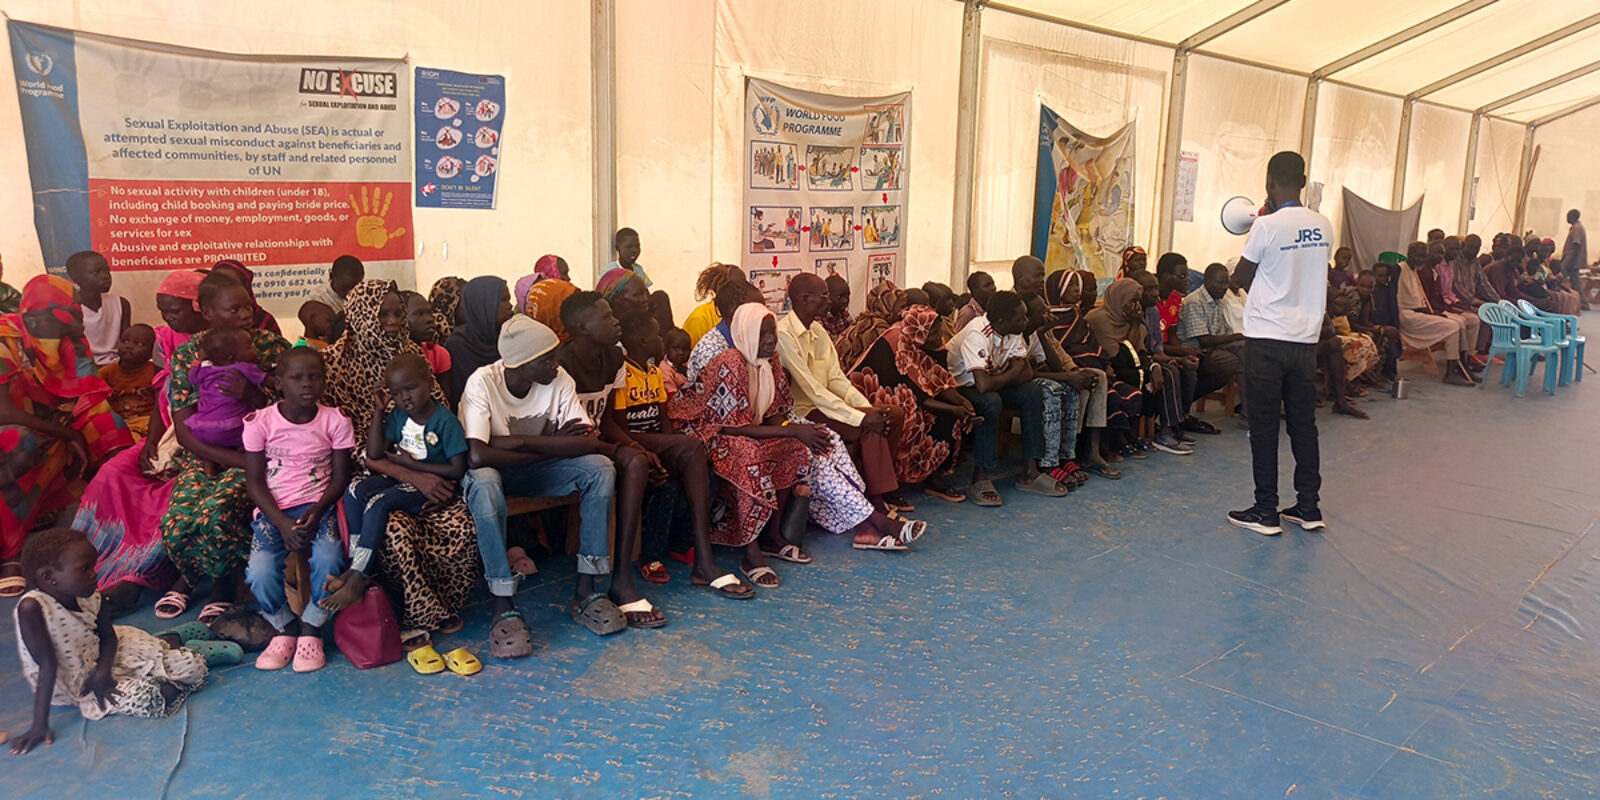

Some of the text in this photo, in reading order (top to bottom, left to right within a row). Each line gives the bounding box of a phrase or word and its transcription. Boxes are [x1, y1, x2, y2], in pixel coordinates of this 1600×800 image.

[303, 67, 394, 100] NO EXCUSE
[308, 100, 330, 108] SEXUAL
[331, 102, 367, 110] EXPLOITATION
[785, 108, 846, 122] WORLD FOOD
[124, 117, 385, 138] Sexual Exploitation and Abuse (SEA) is actual or
[783, 122, 843, 137] PROGRAMME
[103, 133, 402, 151] attempted sexual misconduct against beneficiaries and
[112, 147, 397, 165] affected communities, by staff and related personnel
[248, 166, 282, 176] of UN
[110, 186, 330, 198] No sexual activity with children (under 18),
[109, 200, 350, 212] including child booking and paying bride price.
[110, 214, 127, 224] No
[128, 214, 179, 226] exchange
[180, 213, 193, 223] of
[194, 215, 234, 225] money,
[235, 213, 302, 225] employment,
[303, 213, 337, 224] goods,
[110, 228, 193, 238] services for sex
[1294, 228, 1323, 243] JRS
[111, 238, 333, 252] Abusive and exploitative relationships with
[111, 252, 267, 267] beneficiaries are PROHIBITED
[264, 268, 326, 278] confidentially
[264, 280, 286, 288] 0910
[255, 289, 282, 298] where
[285, 290, 301, 298] you
